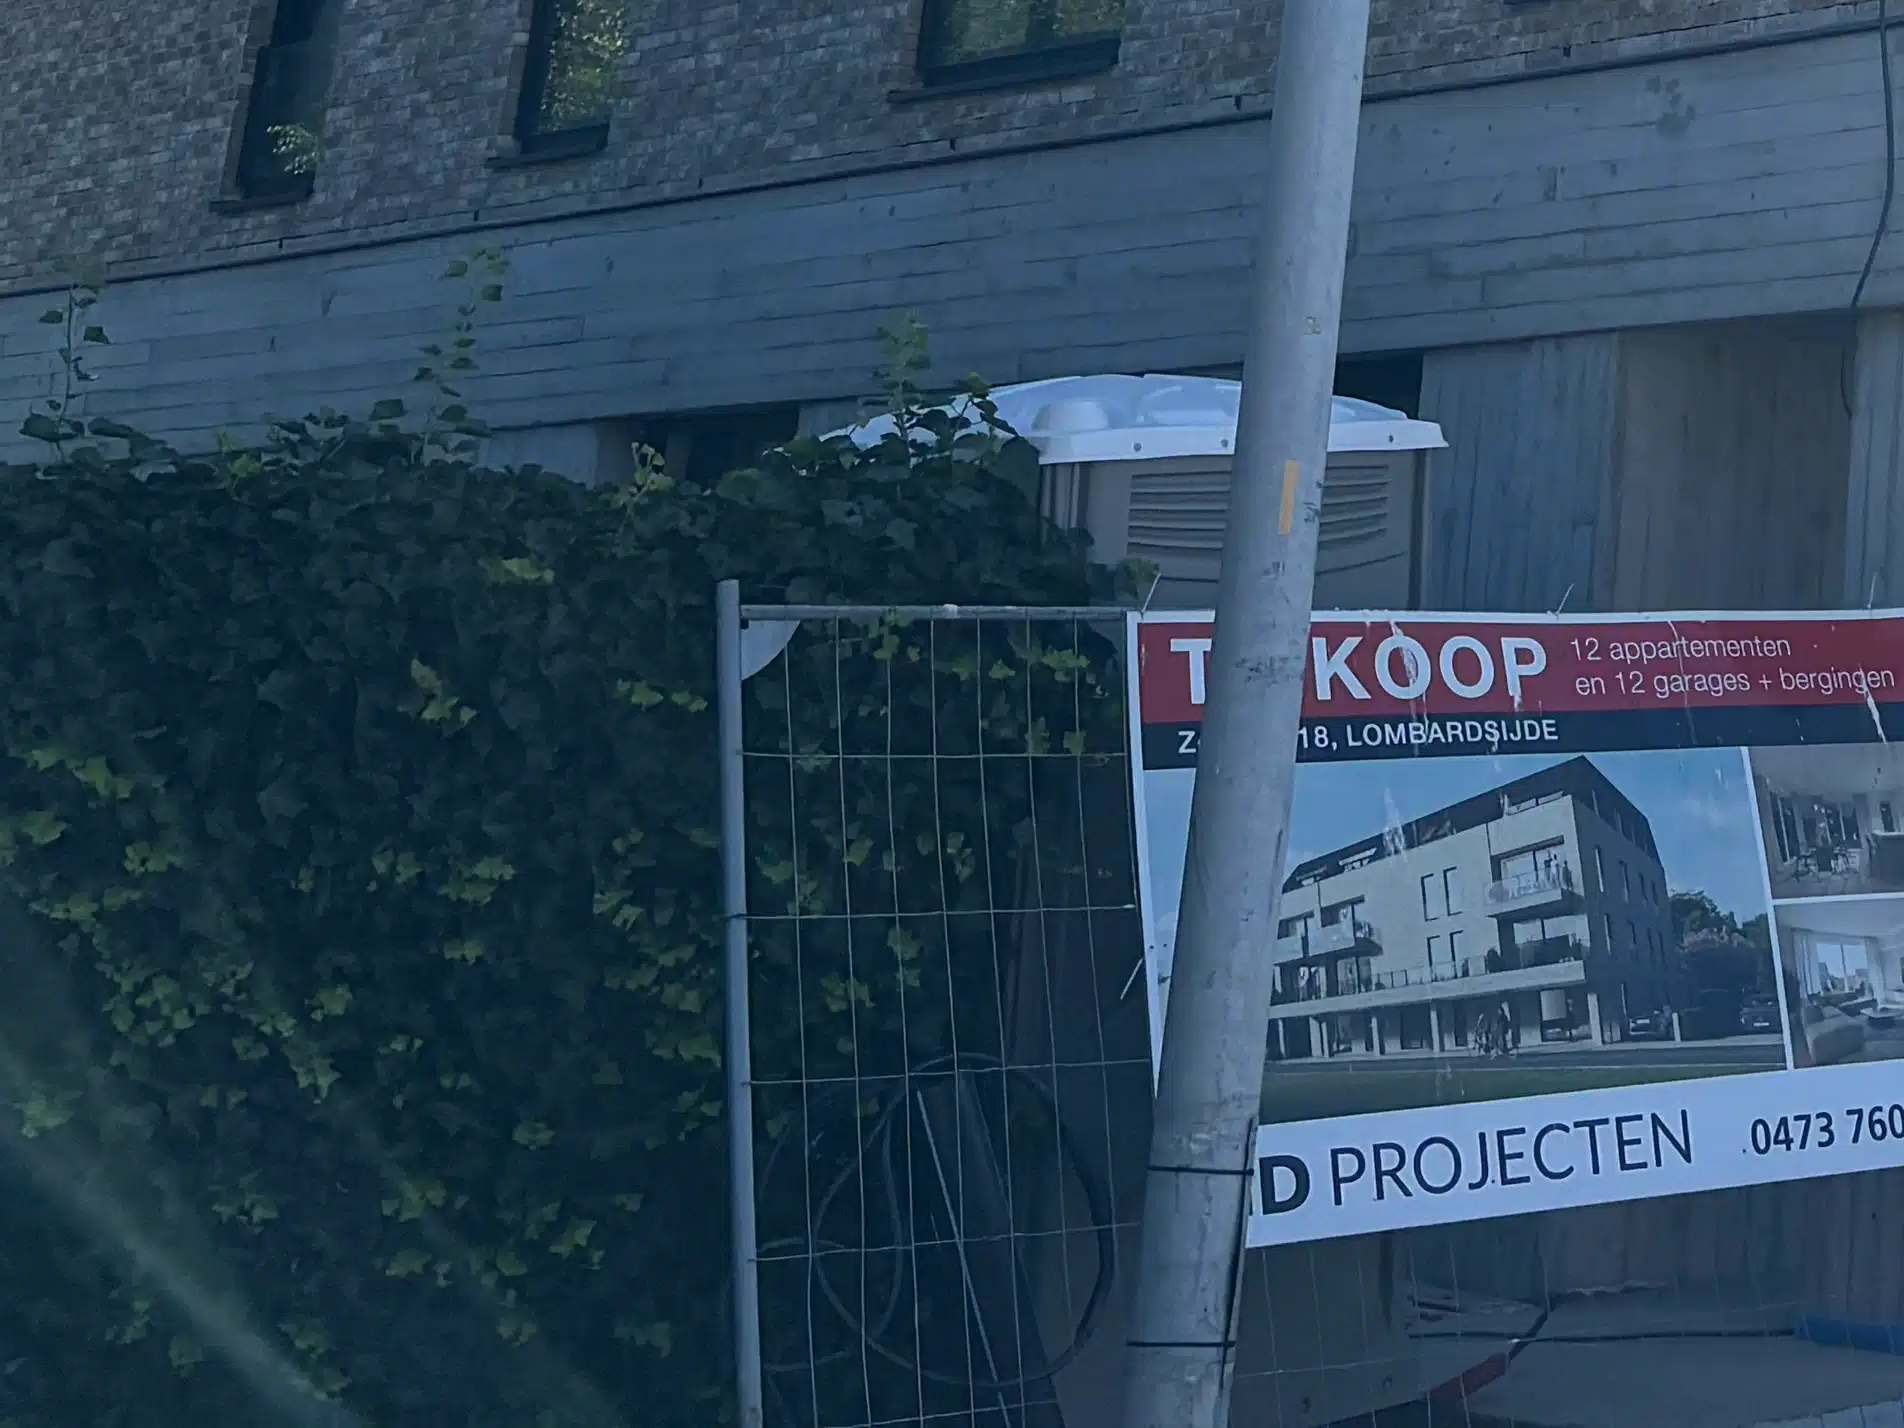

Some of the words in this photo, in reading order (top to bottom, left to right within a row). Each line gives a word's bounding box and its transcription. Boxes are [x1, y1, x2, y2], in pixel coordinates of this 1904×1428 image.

[1571, 637, 1602, 662] 12
[1609, 634, 1792, 665] appartementen
[1170, 637, 1213, 704] T
[1311, 634, 1548, 701] KOOP
[1575, 673, 1606, 696] en
[1614, 670, 1646, 694] 12
[1652, 672, 1751, 699] garages
[1758, 675, 1774, 691] +
[1778, 666, 1896, 695] bergingen
[1347, 719, 1560, 749] LOMBARDSIJDE
[1750, 1111, 1837, 1155] 0473
[1330, 1109, 1695, 1207] PROJECTEN
